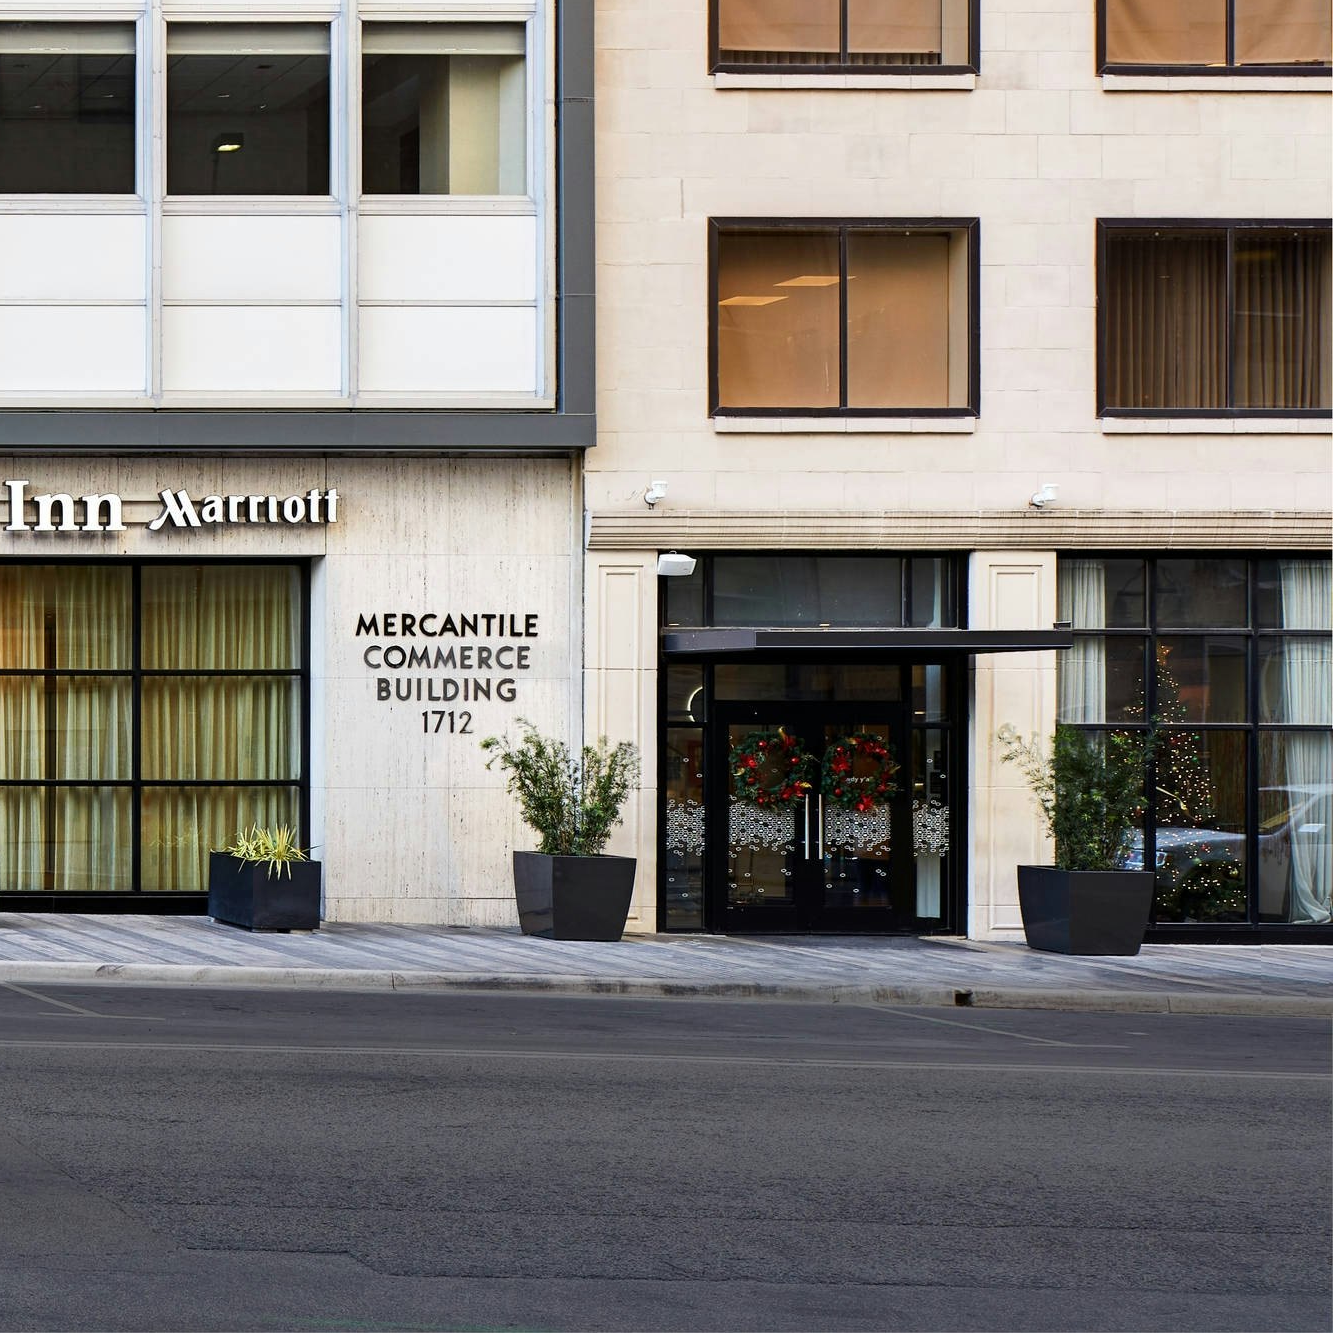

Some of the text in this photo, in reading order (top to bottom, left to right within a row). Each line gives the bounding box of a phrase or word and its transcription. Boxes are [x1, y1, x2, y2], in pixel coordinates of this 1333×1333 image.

[4, 479, 127, 532] Inn
[147, 487, 341, 532] Marriott
[355, 613, 539, 637] MERCANTILE
[363, 645, 531, 670] COMMERCE
[376, 677, 517, 702] BUILDING
[421, 710, 474, 734] 1712
